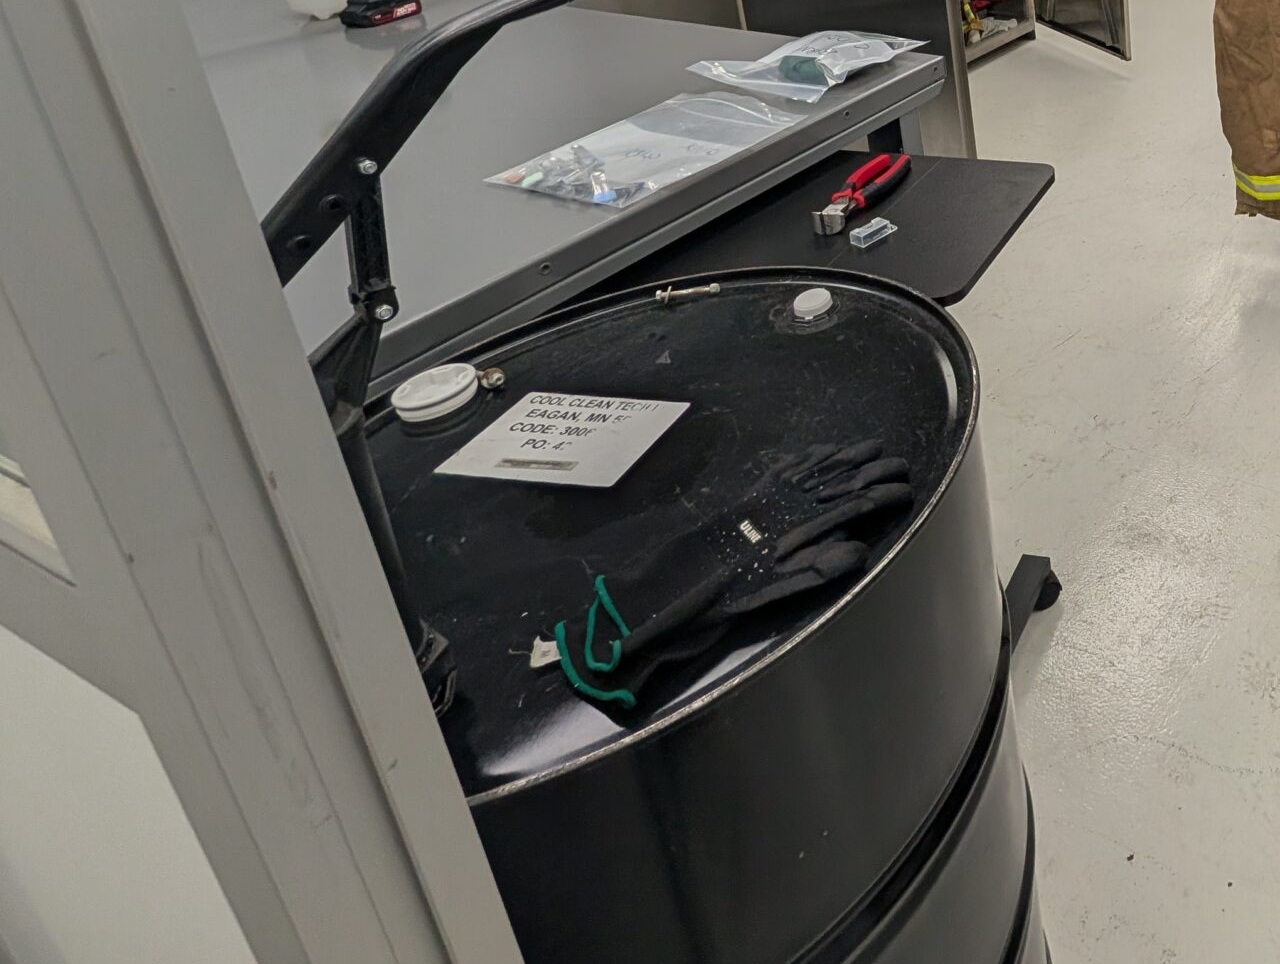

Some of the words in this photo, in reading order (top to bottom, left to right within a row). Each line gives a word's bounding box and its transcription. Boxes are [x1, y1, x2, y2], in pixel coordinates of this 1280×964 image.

[530, 395, 566, 406] COOL
[568, 397, 614, 410] CLEAN
[525, 408, 582, 422] EAGAN,
[584, 412, 612, 423] MN
[509, 422, 559, 434] CODE:
[520, 438, 551, 450] PO:
